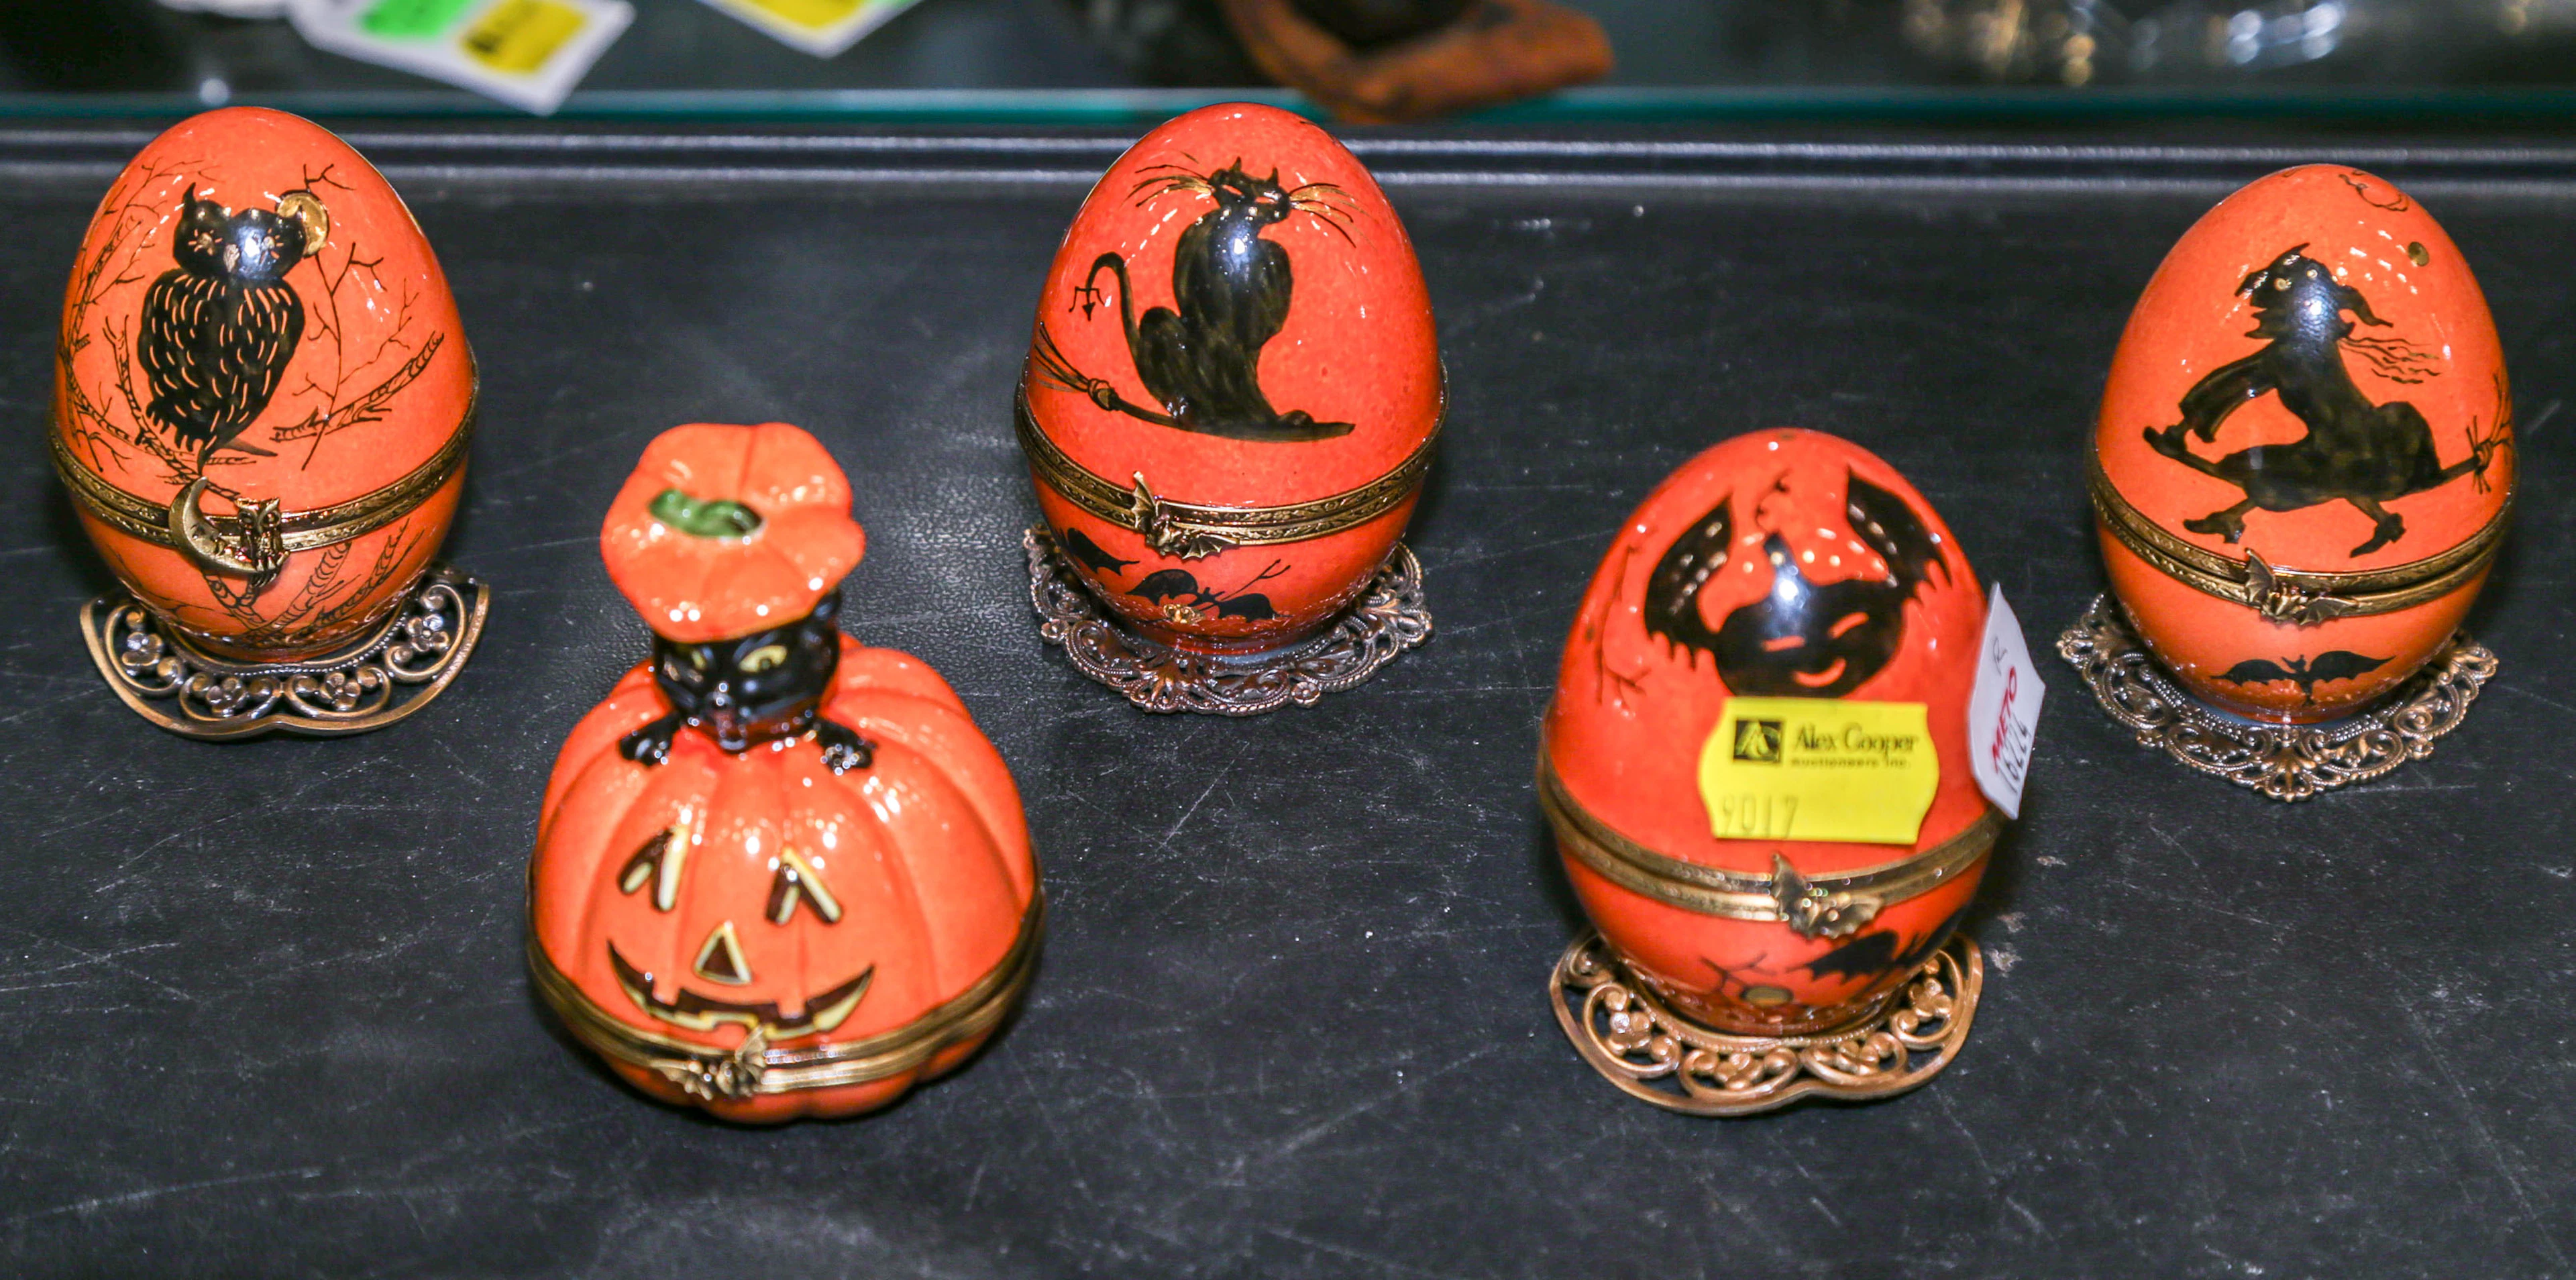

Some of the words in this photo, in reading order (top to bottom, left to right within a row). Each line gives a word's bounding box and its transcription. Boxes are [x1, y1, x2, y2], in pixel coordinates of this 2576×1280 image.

[1794, 722, 1837, 751] Alex
[1841, 721, 1917, 758] Cooper
[1992, 665, 2017, 774] METO
[1721, 793, 1799, 838] 9017
